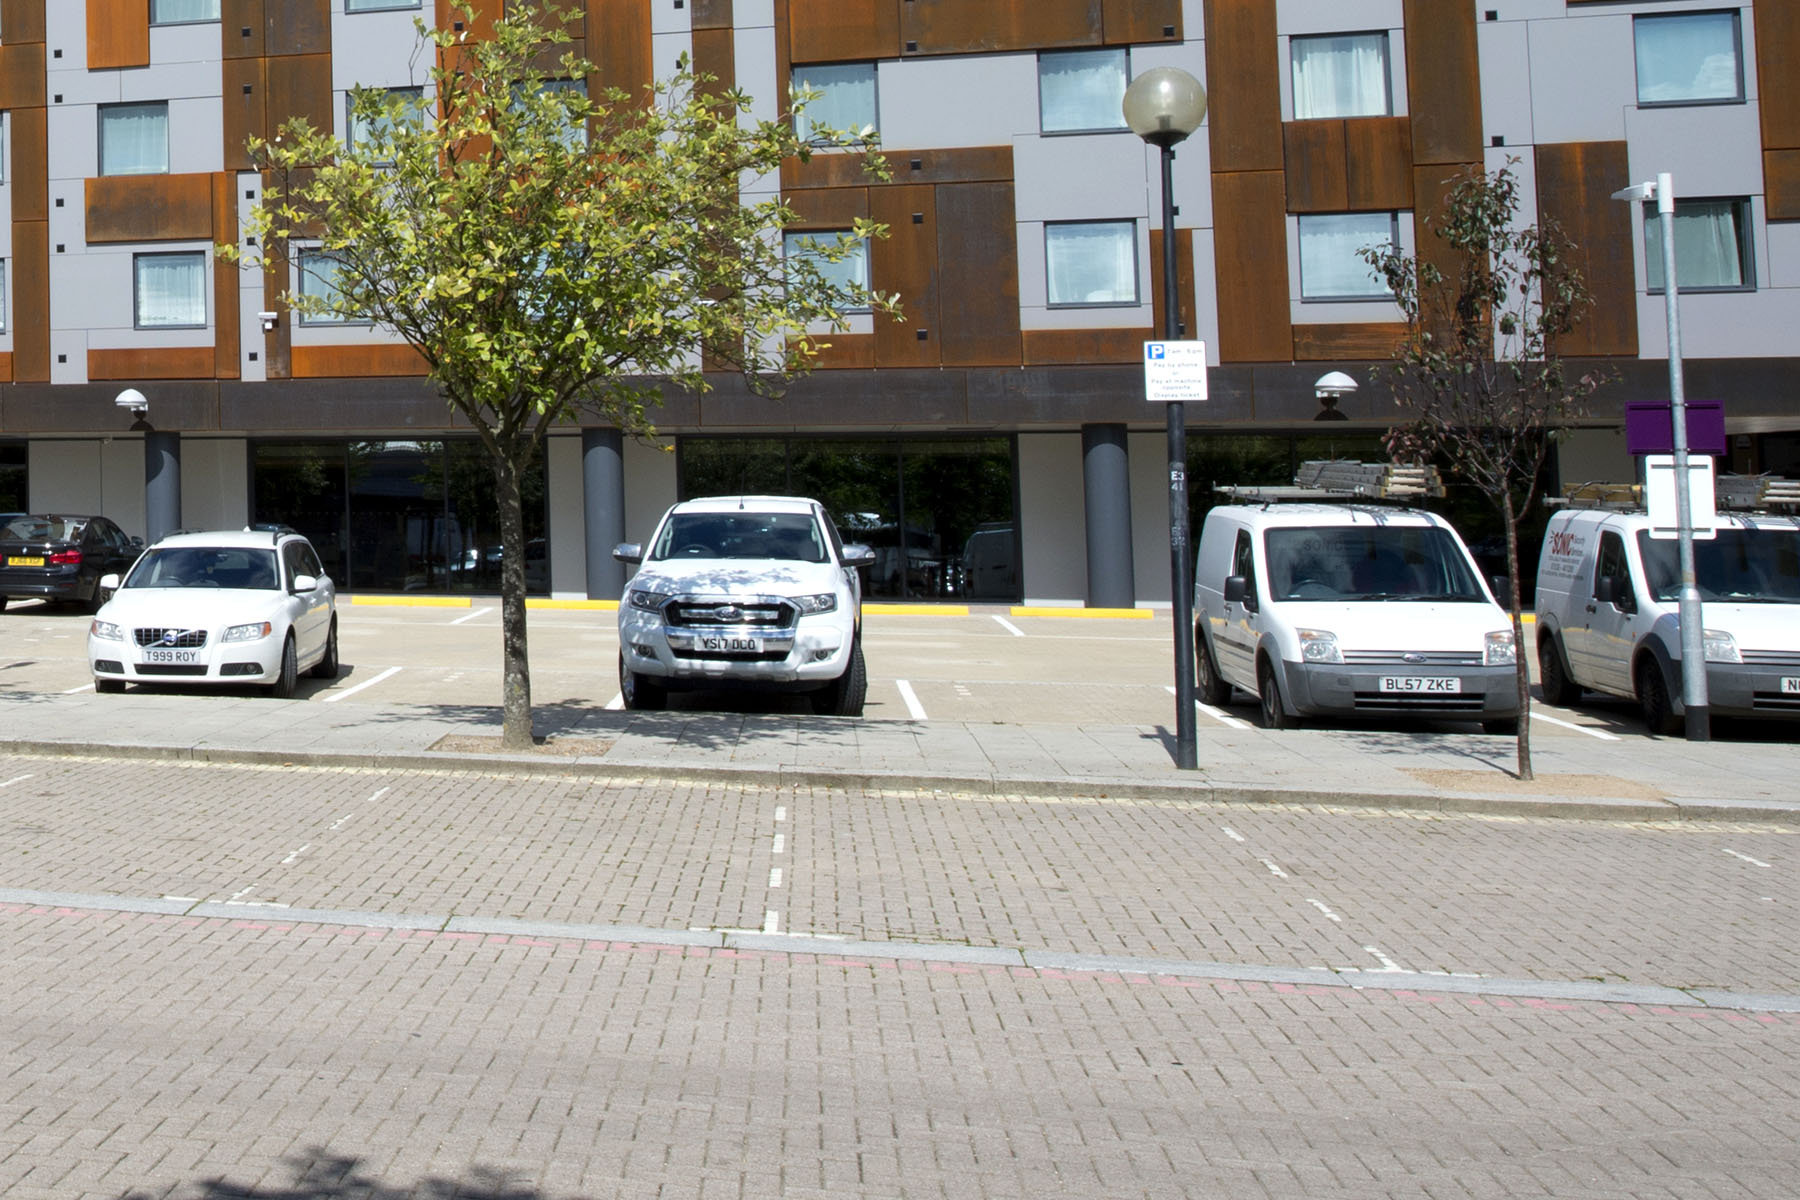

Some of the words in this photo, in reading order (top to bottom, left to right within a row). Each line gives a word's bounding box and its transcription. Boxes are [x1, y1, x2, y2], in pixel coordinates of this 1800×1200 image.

[1552, 532, 1575, 556] SONIC
[702, 638, 728, 649] YS17
[146, 651, 173, 661] T999
[175, 651, 196, 662] ROY
[1385, 678, 1422, 690] BL57
[1426, 679, 1454, 690] ZKE
